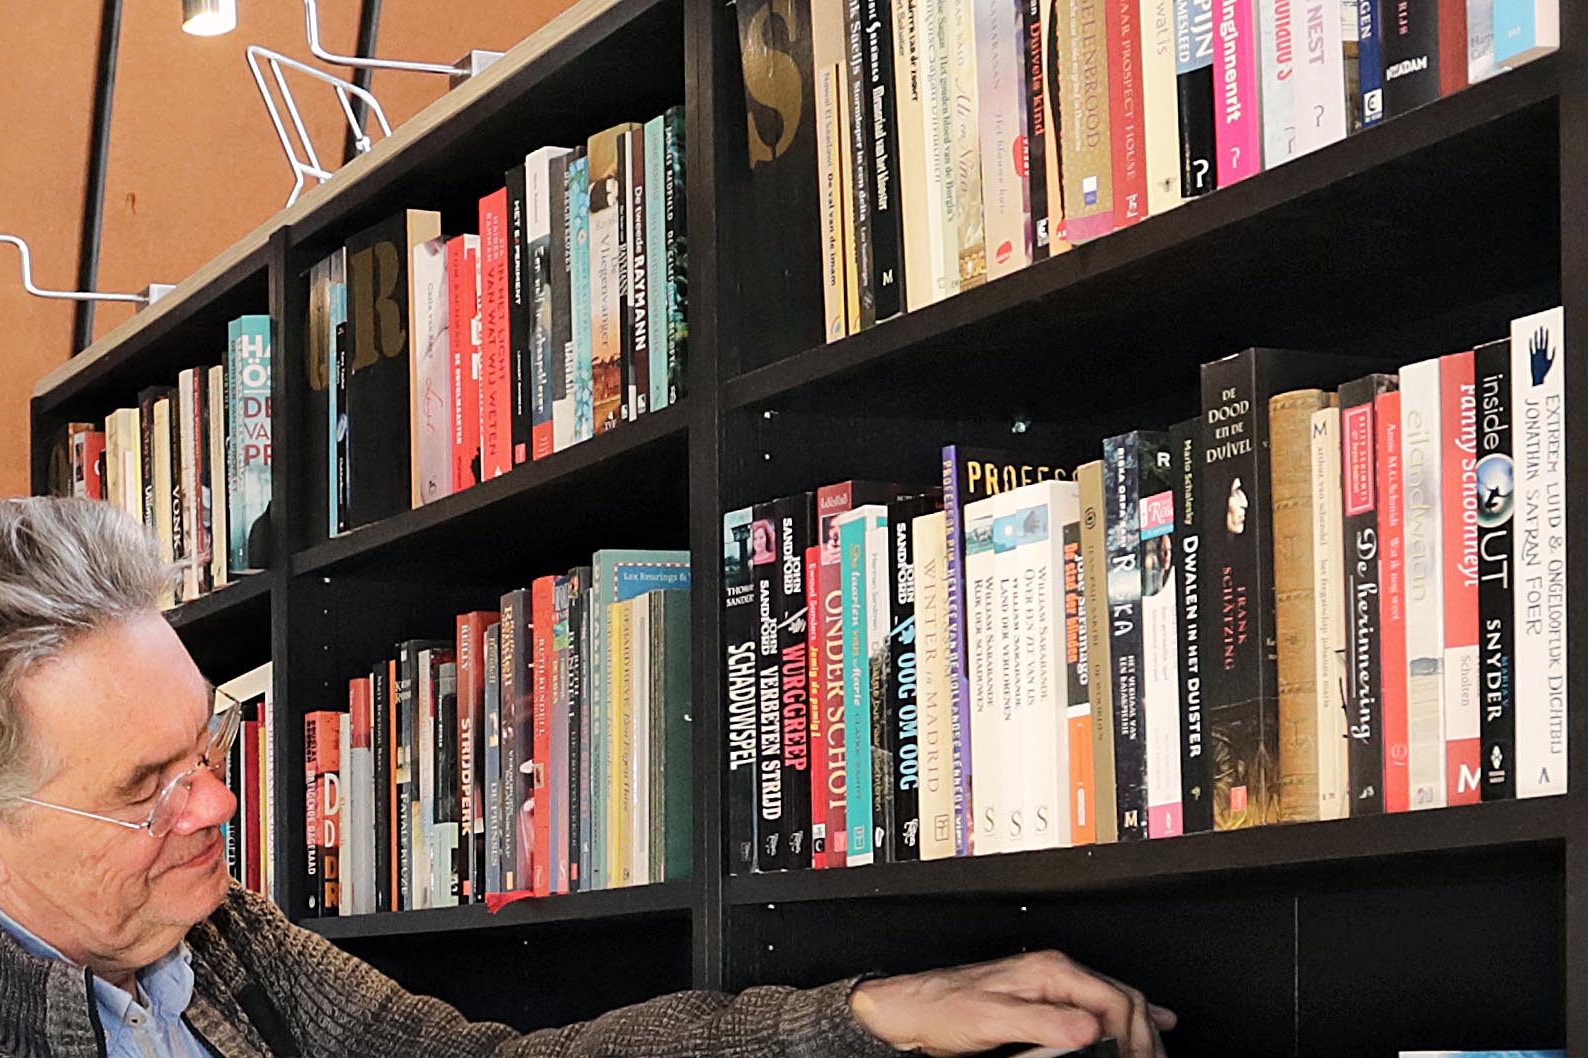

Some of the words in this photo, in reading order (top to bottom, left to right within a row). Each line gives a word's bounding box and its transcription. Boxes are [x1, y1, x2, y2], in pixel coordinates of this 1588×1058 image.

[1029, 22, 1043, 89] Duivels
[1308, 7, 1324, 64] NEST
[742, 0, 803, 170] S
[1122, 41, 1134, 118] PROSPECT
[853, 81, 866, 148] Stormloper
[1033, 95, 1045, 136] kind
[827, 173, 834, 188] De
[857, 151, 866, 164] in
[857, 166, 865, 187] een
[1125, 125, 1136, 178] HOUSE
[634, 187, 644, 204] De
[859, 190, 868, 221] delta
[634, 207, 644, 253] tweede
[829, 236, 836, 249] de
[600, 235, 613, 346] Vliegenvanger
[633, 255, 646, 351] RAYMANN
[1208, 400, 1250, 424] DOOD
[1222, 387, 1237, 400] DE
[1482, 374, 1509, 449] inside
[1206, 439, 1253, 463] DUIVEL
[1231, 422, 1244, 435] DE
[1524, 399, 1541, 480] JONATHAN
[1545, 395, 1561, 473] EXTREEM
[172, 485, 184, 551] VONK
[1521, 489, 1542, 567] SAFRAN
[1546, 483, 1561, 528] LUID
[783, 518, 794, 595] SANDFORD
[1065, 543, 1078, 561] De
[1356, 528, 1376, 577] De
[1549, 536, 1562, 555] &
[792, 557, 801, 593] JOHN
[1066, 565, 1078, 588] stad
[1067, 593, 1078, 614] der
[1182, 536, 1199, 619] DWALEN
[1187, 623, 1197, 641] IN
[1222, 566, 1236, 670] SCHÄTZING
[1235, 586, 1247, 645] FRANK
[1526, 576, 1543, 636] FOER
[1547, 560, 1563, 668] ONGELOOFLIJK
[825, 590, 847, 698] ONDER
[1067, 619, 1079, 663] blinden
[1187, 646, 1199, 672] HET
[1351, 577, 1378, 744] herinnering
[897, 652, 918, 699] OOG
[1486, 619, 1502, 722] SNYDER
[728, 641, 756, 770] SCHADUWSPEL
[760, 665, 781, 756] VERBETEN
[782, 642, 807, 771] WURGGREEP
[899, 706, 918, 737] OM
[1187, 677, 1202, 757] DUISTER
[1547, 675, 1564, 755] DICHTBIJ
[460, 718, 472, 835] STRIJDPERK
[826, 706, 848, 812] SCHOT
[900, 744, 919, 790] OOG
[761, 761, 781, 820] STRIJD
[307, 825, 316, 875] DAGERAAD
